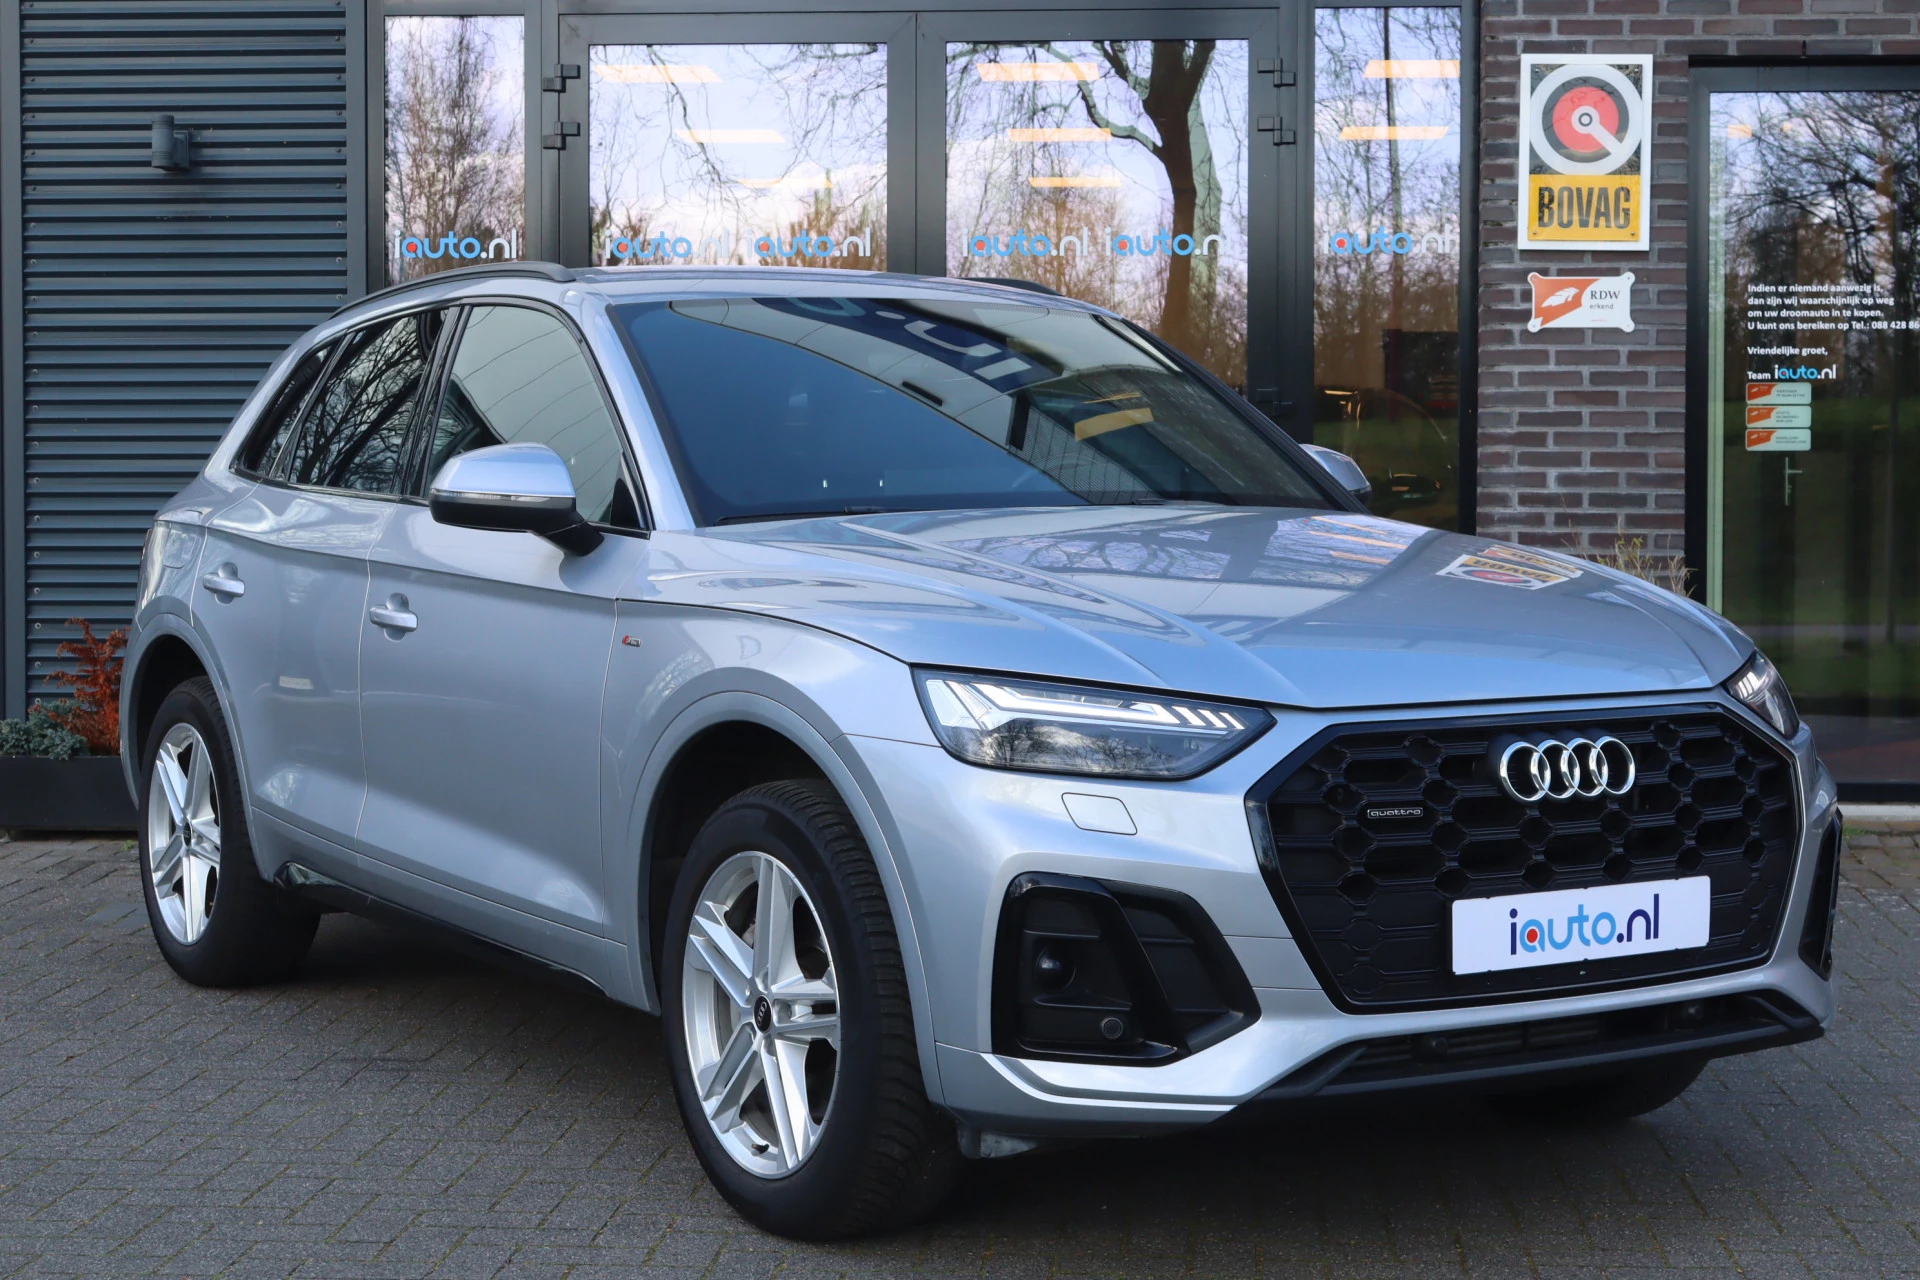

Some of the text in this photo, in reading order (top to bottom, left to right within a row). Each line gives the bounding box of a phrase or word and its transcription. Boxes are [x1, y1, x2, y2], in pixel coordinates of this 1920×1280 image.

[1538, 186, 1630, 229] BOVAG
[393, 229, 518, 259] iauto.nl
[604, 228, 730, 259] iauto.nl
[746, 228, 872, 258] iauto.nl
[961, 226, 1089, 257] iauto.nl
[1322, 223, 1452, 255] iauto.nl
[1590, 290, 1621, 300] RDW
[1747, 284, 1776, 292] Indien
[1789, 284, 1829, 292] niemand
[1830, 283, 1872, 294] aanwezig
[1747, 295, 1895, 306] dan zijn wij waarschijnlijk op weg
[1780, 308, 1830, 317] droomauto
[1831, 308, 1841, 317] in
[1842, 309, 1852, 317] te
[1747, 321, 1755, 330] U
[1756, 321, 1777, 330] kunt
[1796, 321, 1836, 330] bereiken
[1837, 323, 1850, 332] op
[1871, 321, 1888, 330] 088
[1889, 321, 1907, 330] 428
[1747, 347, 1829, 357] Vriendelijke groet,
[1747, 364, 1837, 380] Team iauto.nl
[1370, 809, 1421, 817] quattro
[1509, 893, 1660, 956] iauto.nl
